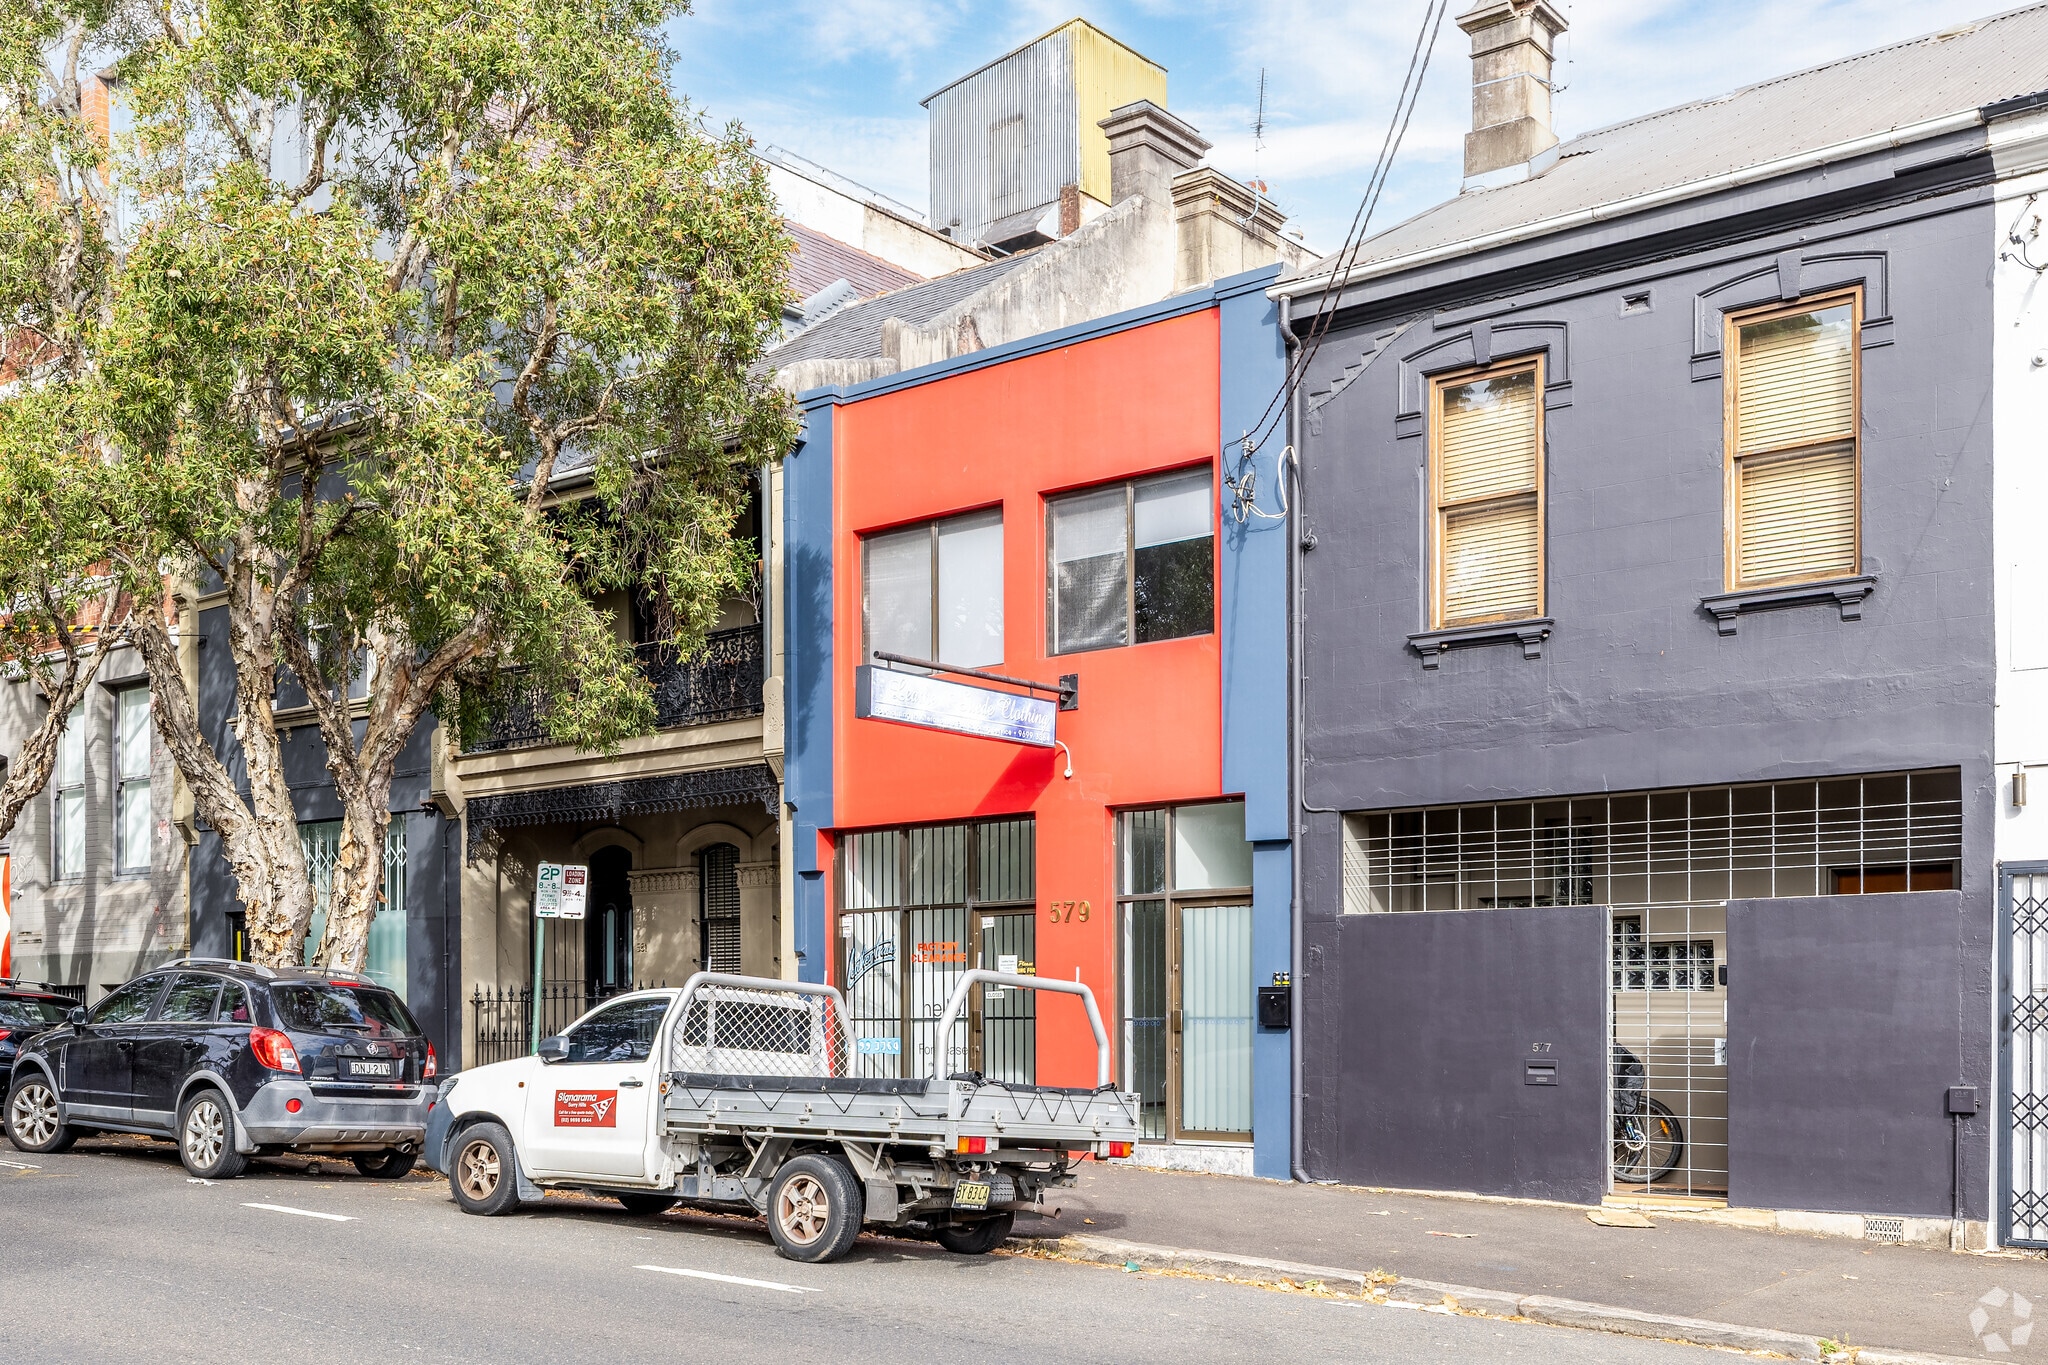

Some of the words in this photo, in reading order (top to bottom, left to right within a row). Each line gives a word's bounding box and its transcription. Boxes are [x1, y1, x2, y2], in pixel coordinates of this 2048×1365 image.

[998, 698, 1051, 732] Clothing
[540, 868, 560, 880] 2P
[1049, 900, 1091, 923] 579
[917, 941, 959, 952] FACTORY
[911, 952, 967, 963] CLEARANCE
[1531, 1042, 1552, 1053] 577
[558, 1092, 597, 1103] Signarama
